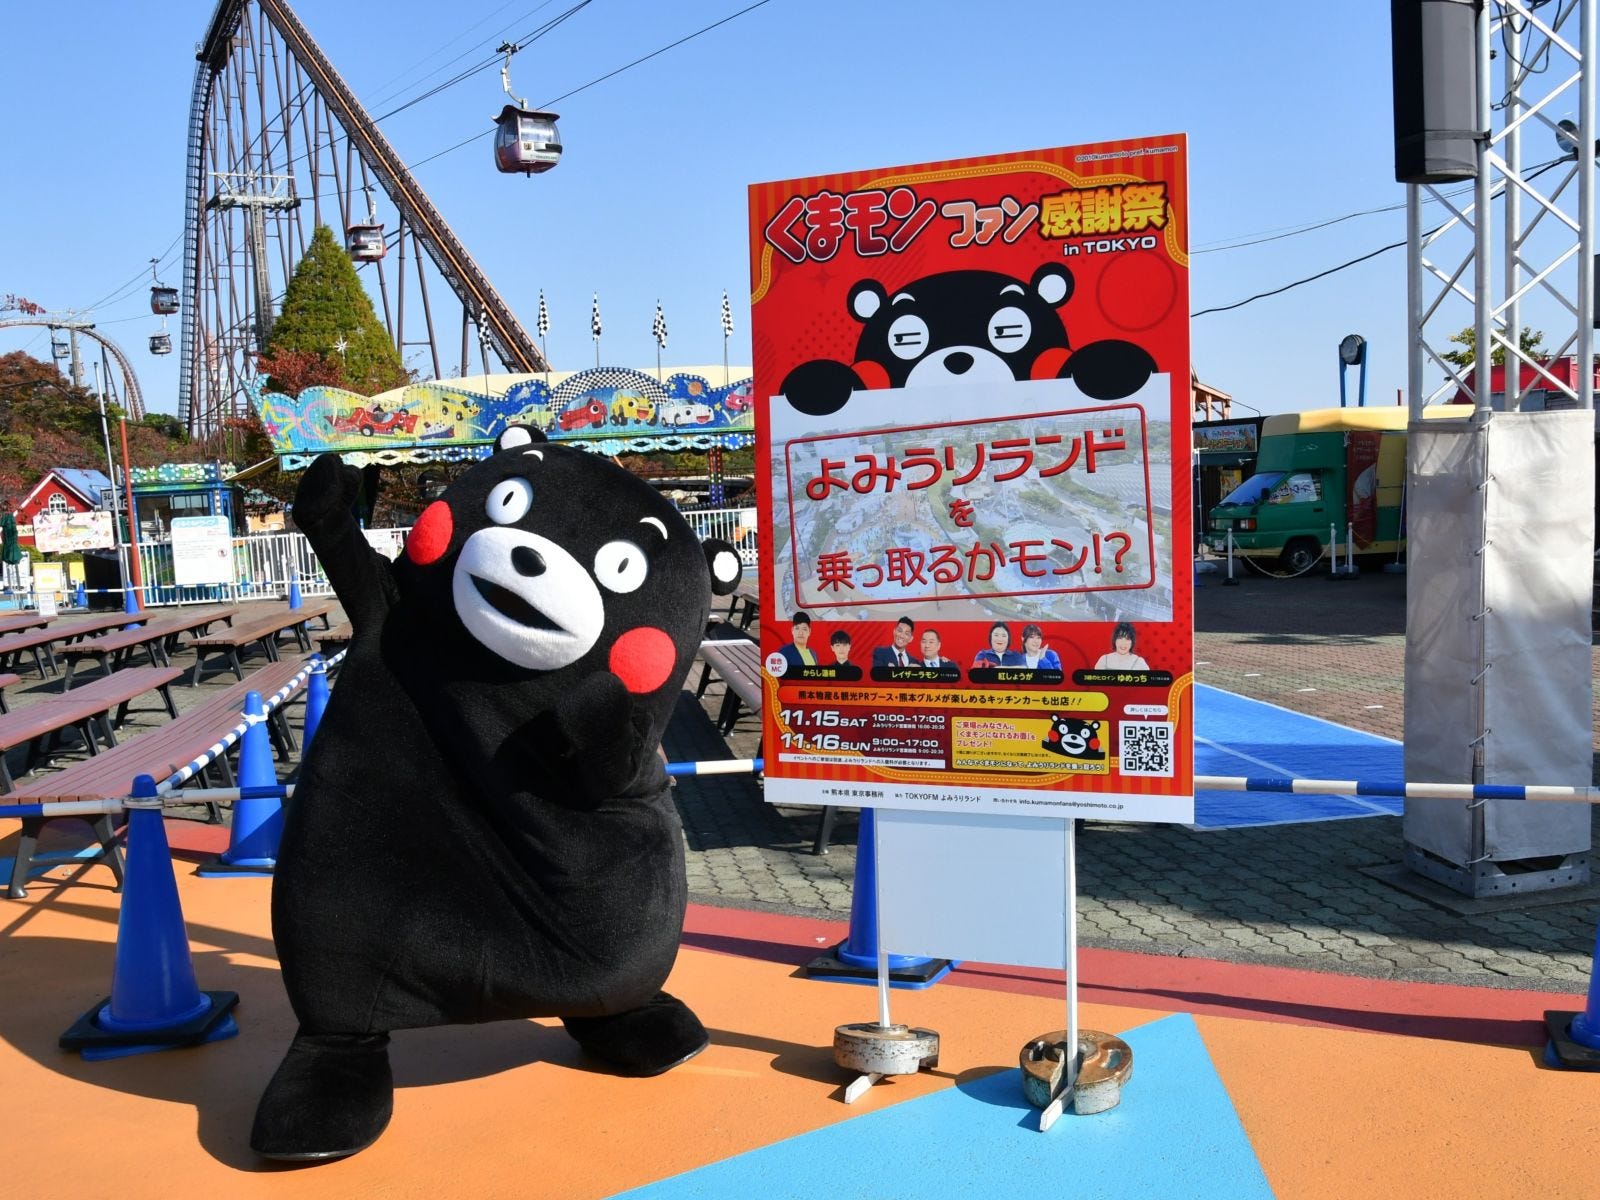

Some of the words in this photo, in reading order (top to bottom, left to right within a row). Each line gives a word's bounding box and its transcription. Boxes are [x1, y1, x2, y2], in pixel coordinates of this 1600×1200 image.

[1063, 243, 1078, 256] in
[1082, 236, 1158, 254] TOKYO
[949, 498, 975, 528] を
[891, 671, 938, 680] レイザーラモン
[997, 672, 1033, 682] 紅しょうが
[1117, 674, 1148, 683] ゆめっち
[831, 789, 850, 797] 熊本県
